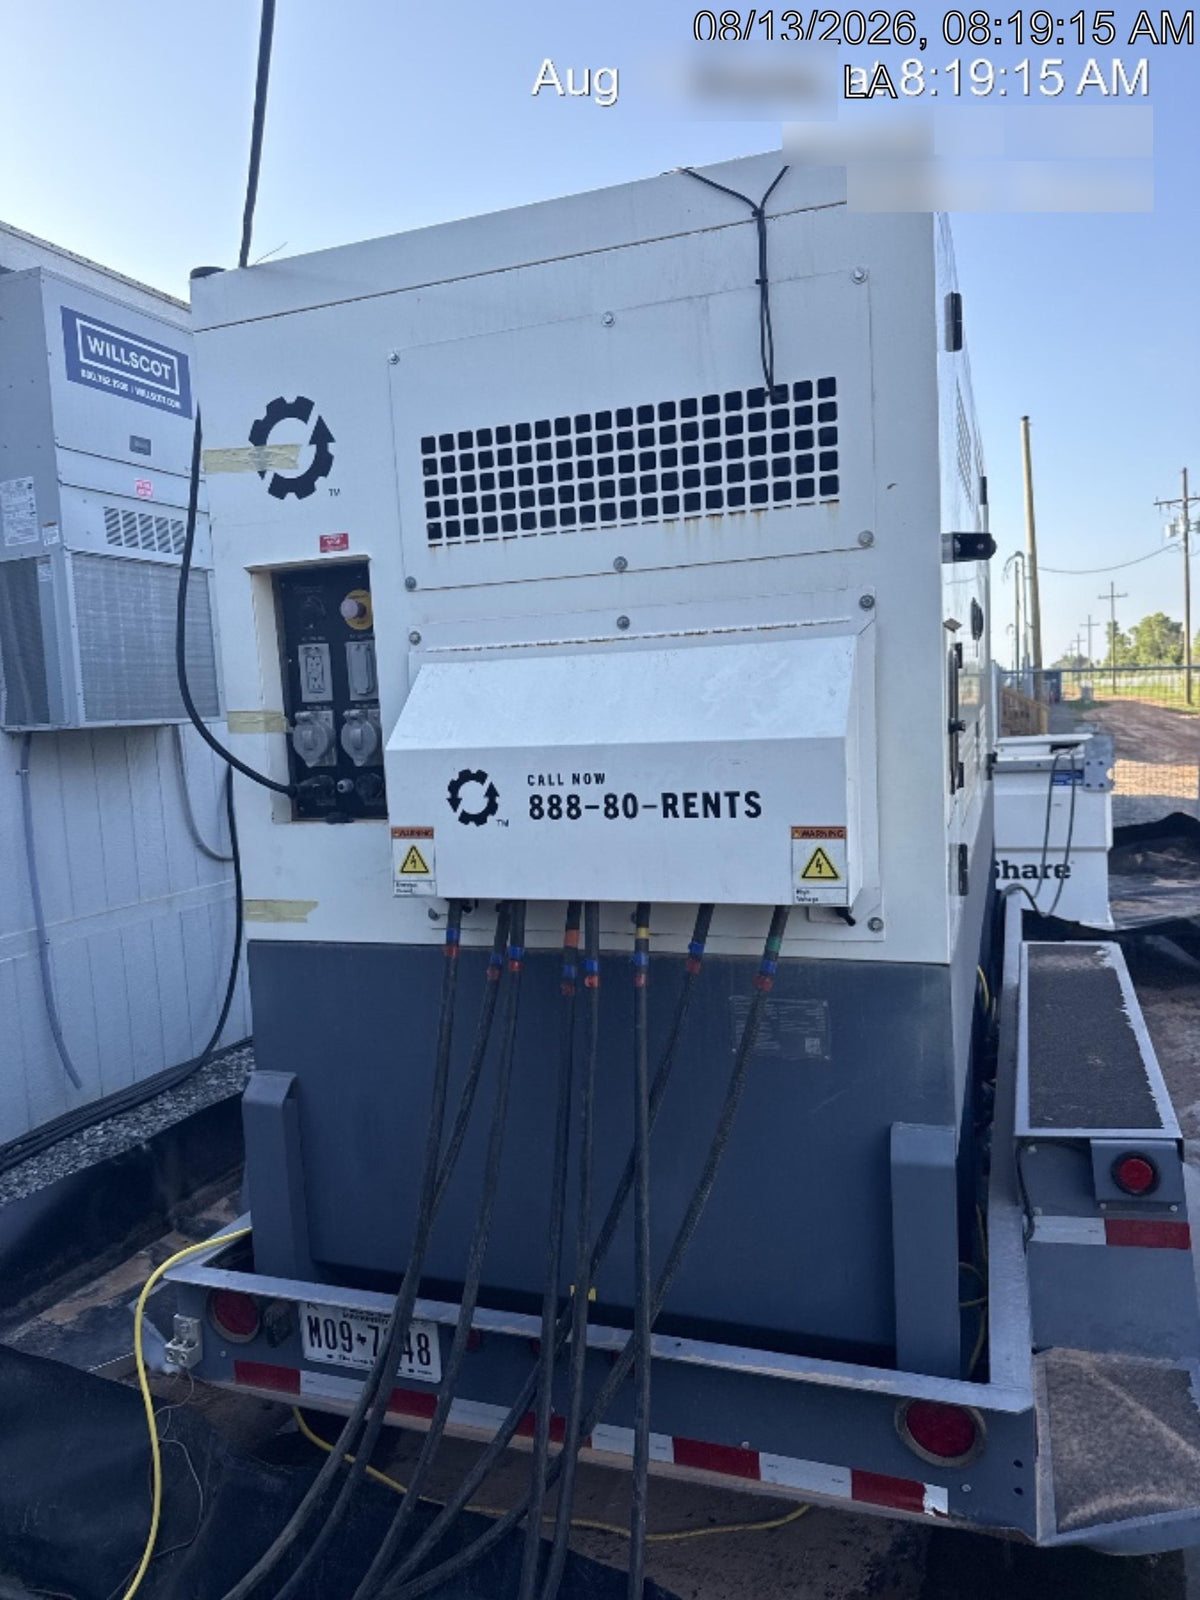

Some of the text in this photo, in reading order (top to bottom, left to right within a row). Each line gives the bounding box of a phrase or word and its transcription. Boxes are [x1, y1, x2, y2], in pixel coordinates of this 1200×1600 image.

[86, 335, 173, 380] WILLSCOT
[527, 772, 606, 787] CALL NOW
[529, 791, 762, 820] 888-80-RENTS
[367, 1325, 431, 1366] 748
